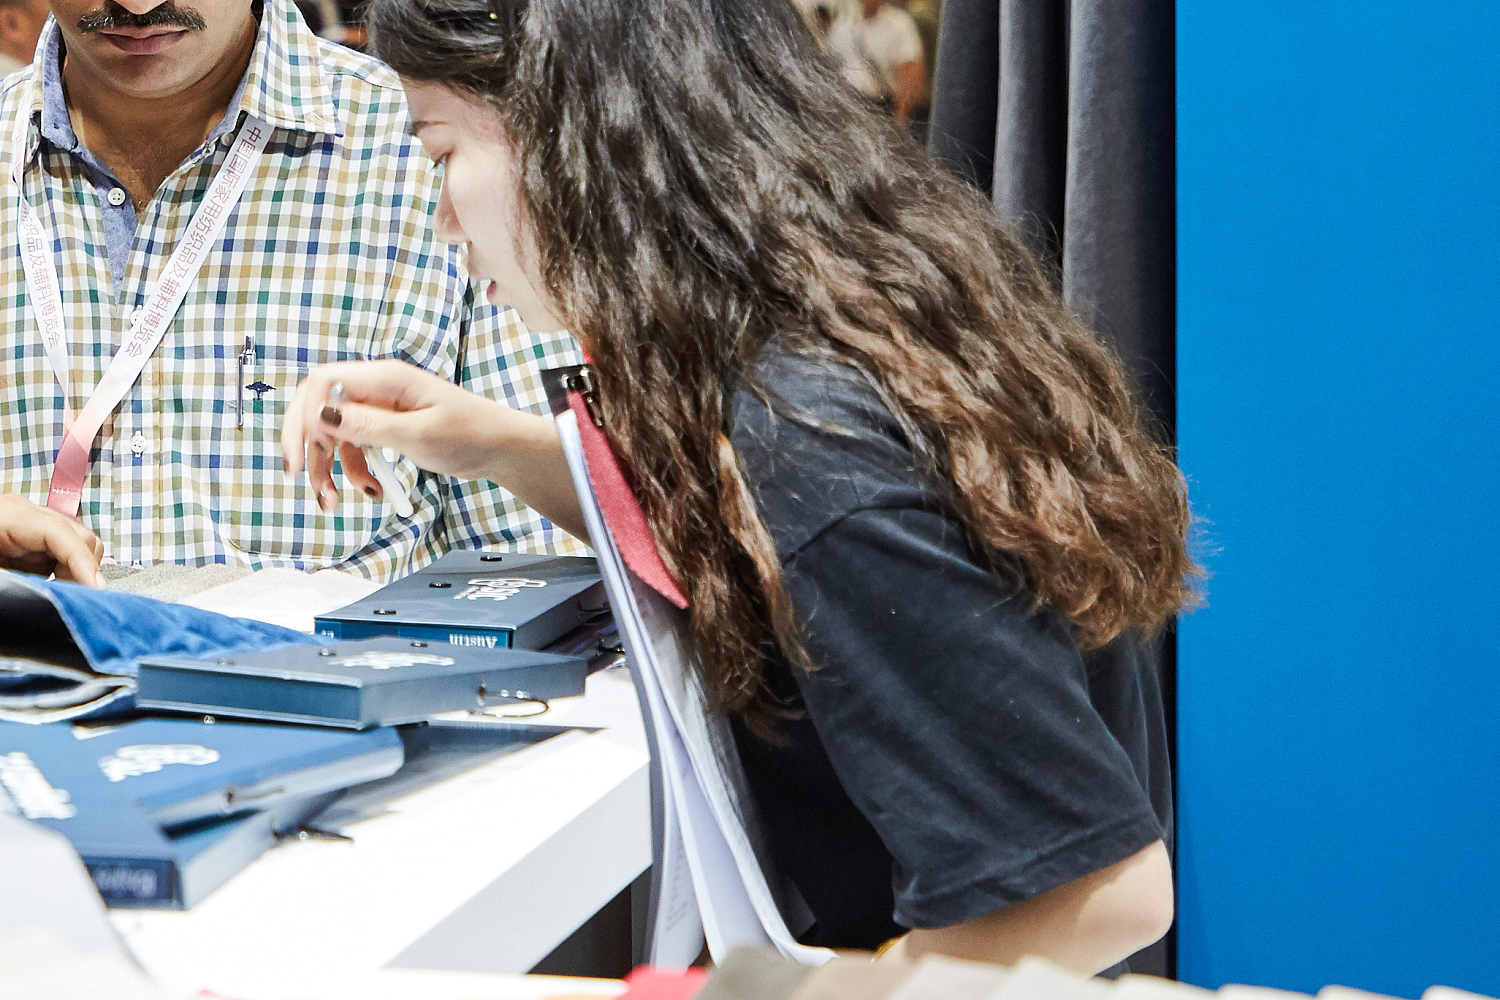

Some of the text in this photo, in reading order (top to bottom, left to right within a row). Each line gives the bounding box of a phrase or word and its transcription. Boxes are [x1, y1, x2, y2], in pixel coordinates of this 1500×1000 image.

[125, 126, 263, 359] 中国国际家用纺织品及辅料博览会
[449, 633, 498, 649] Austin
